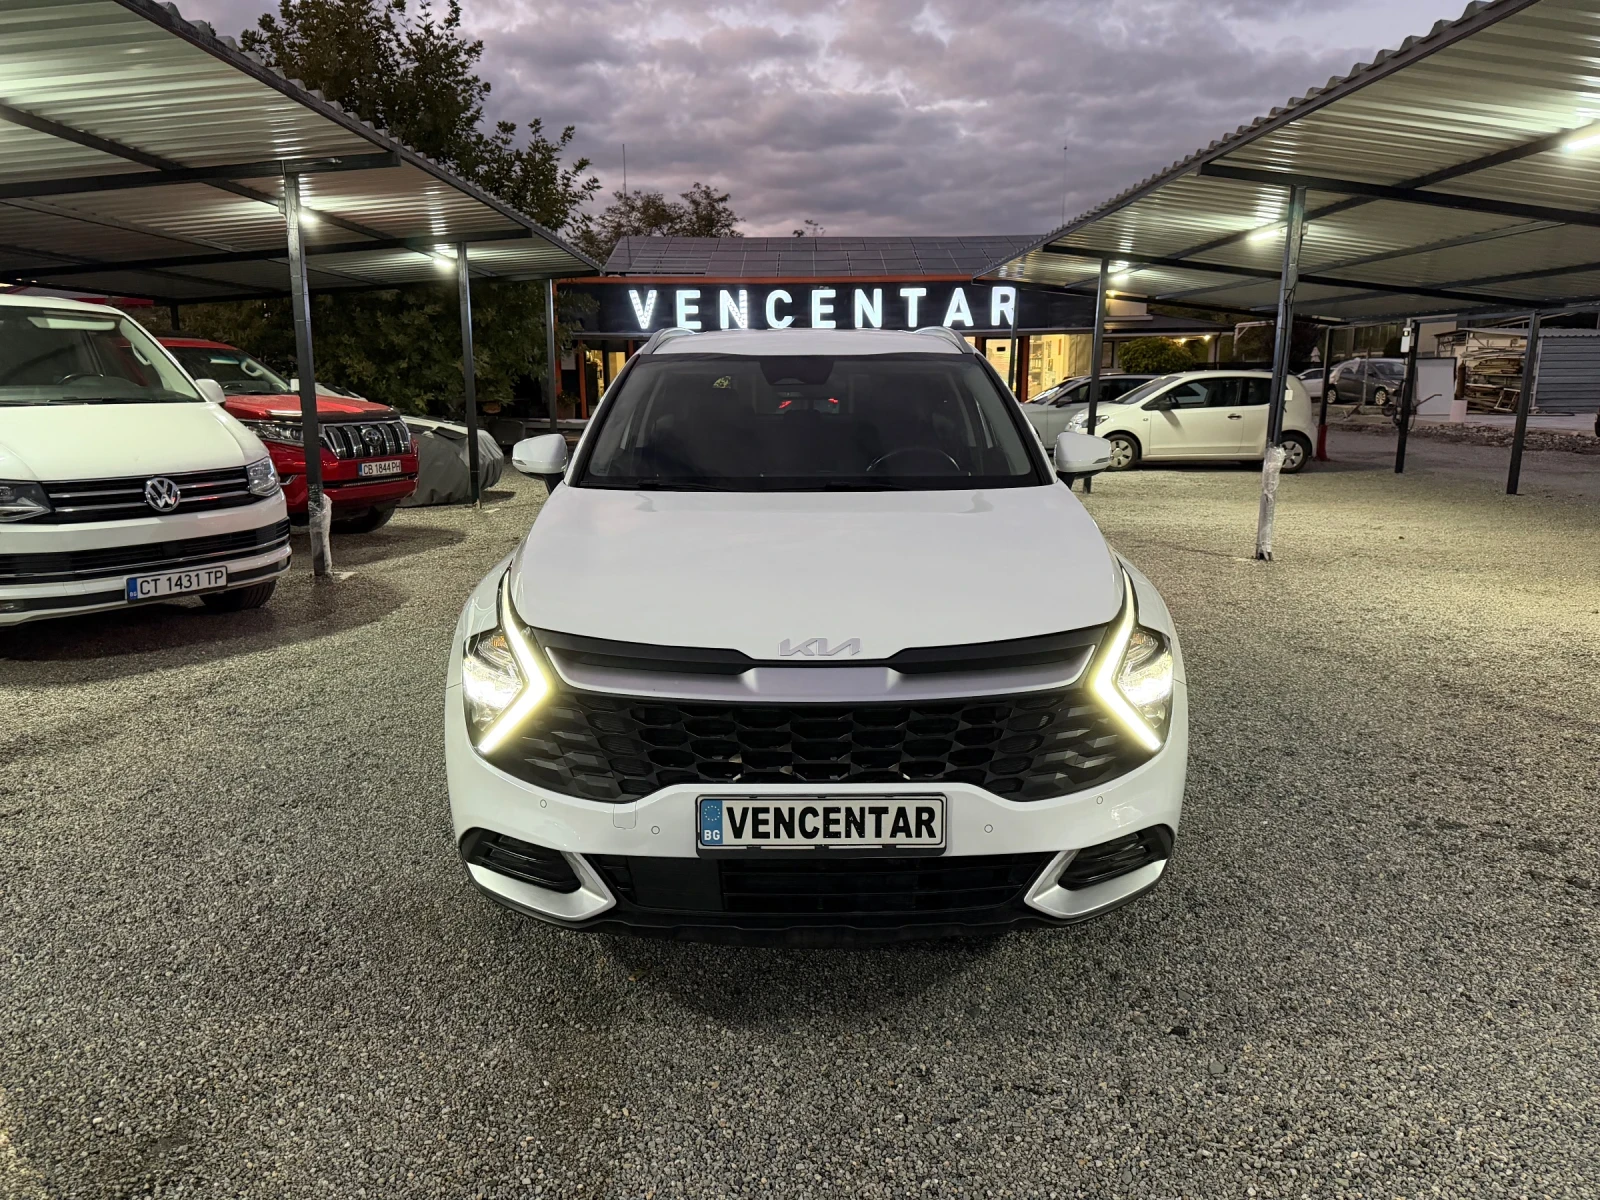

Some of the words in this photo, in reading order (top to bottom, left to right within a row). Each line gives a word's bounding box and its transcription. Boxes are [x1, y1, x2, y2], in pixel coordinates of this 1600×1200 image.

[628, 286, 1016, 331] VENCENTAR
[363, 464, 374, 475] CB
[374, 462, 391, 474] 1844
[391, 461, 401, 472] PH
[140, 578, 160, 595] CT
[166, 572, 200, 591] 1431
[204, 570, 224, 586] TP
[704, 829, 721, 841] BG
[726, 806, 937, 840] VENCENTAR
